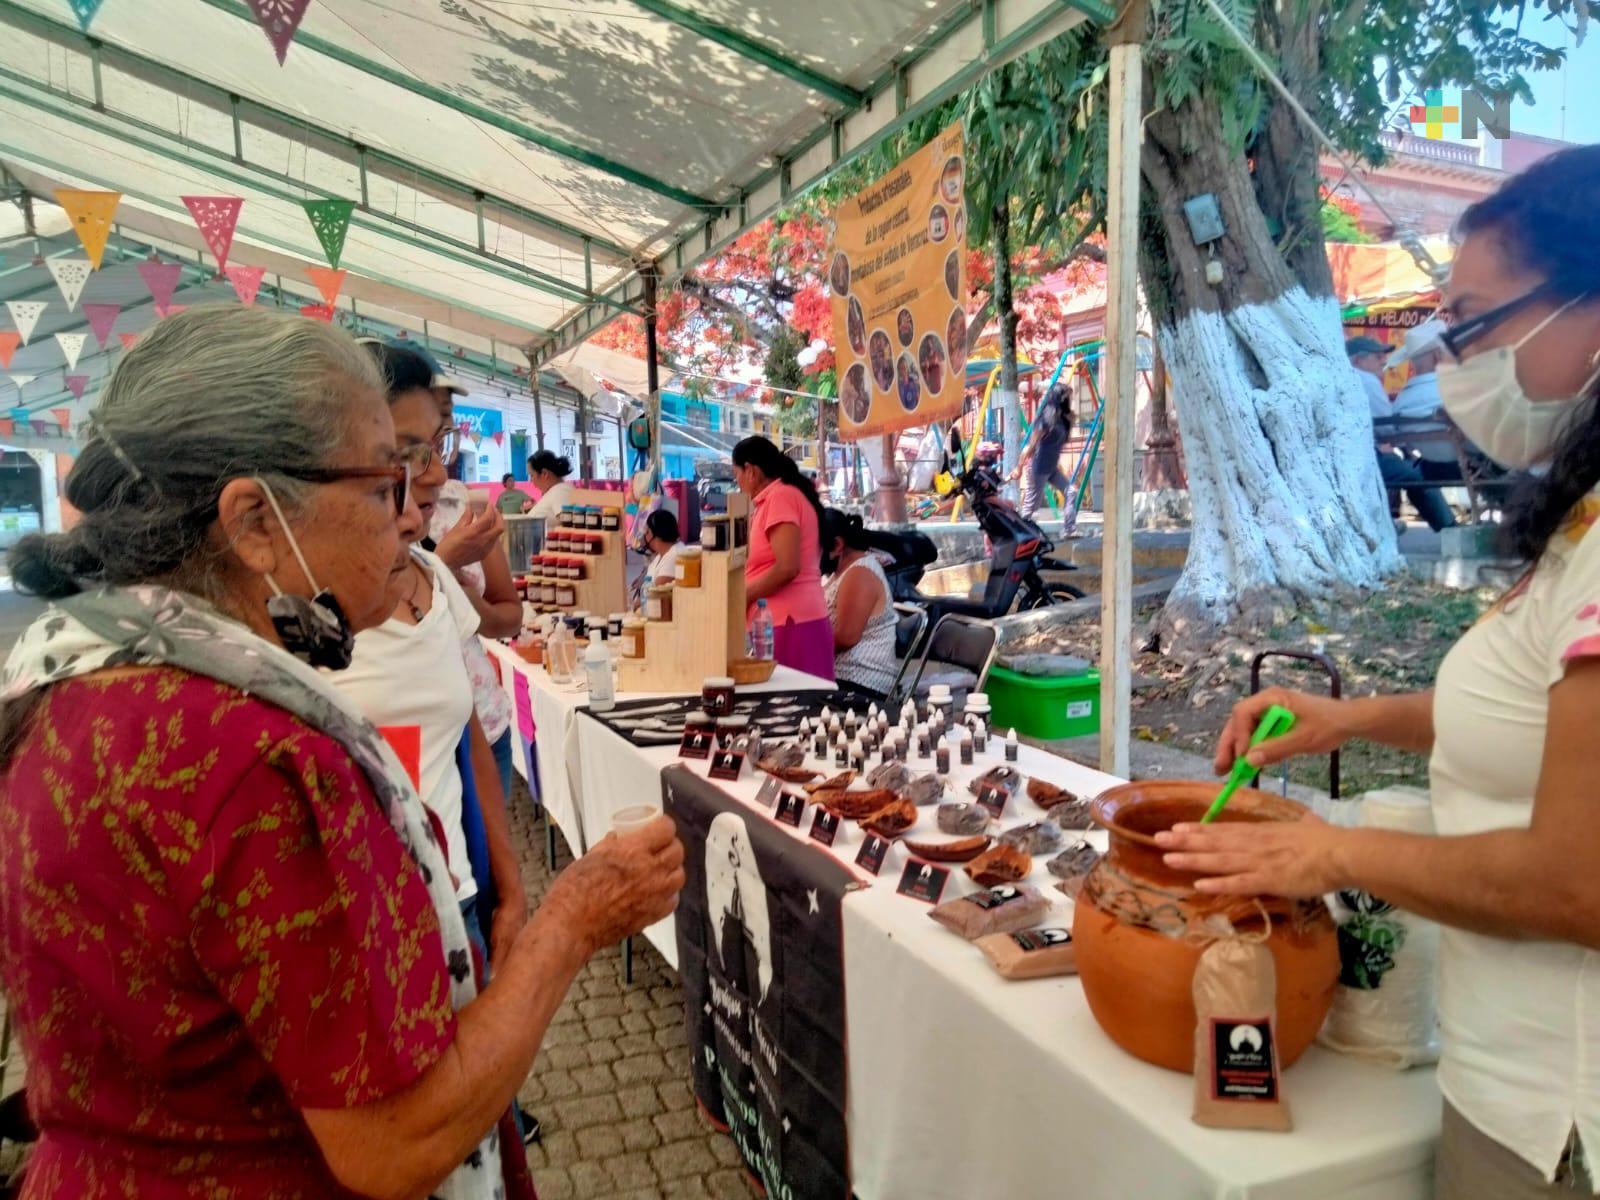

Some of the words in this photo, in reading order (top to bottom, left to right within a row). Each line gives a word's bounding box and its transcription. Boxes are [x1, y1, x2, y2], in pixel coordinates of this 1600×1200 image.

[857, 190, 883, 217] Productos
[881, 168, 913, 202] artesanales
[906, 226, 929, 254] Veracruz
[1380, 310, 1419, 326] HELADO
